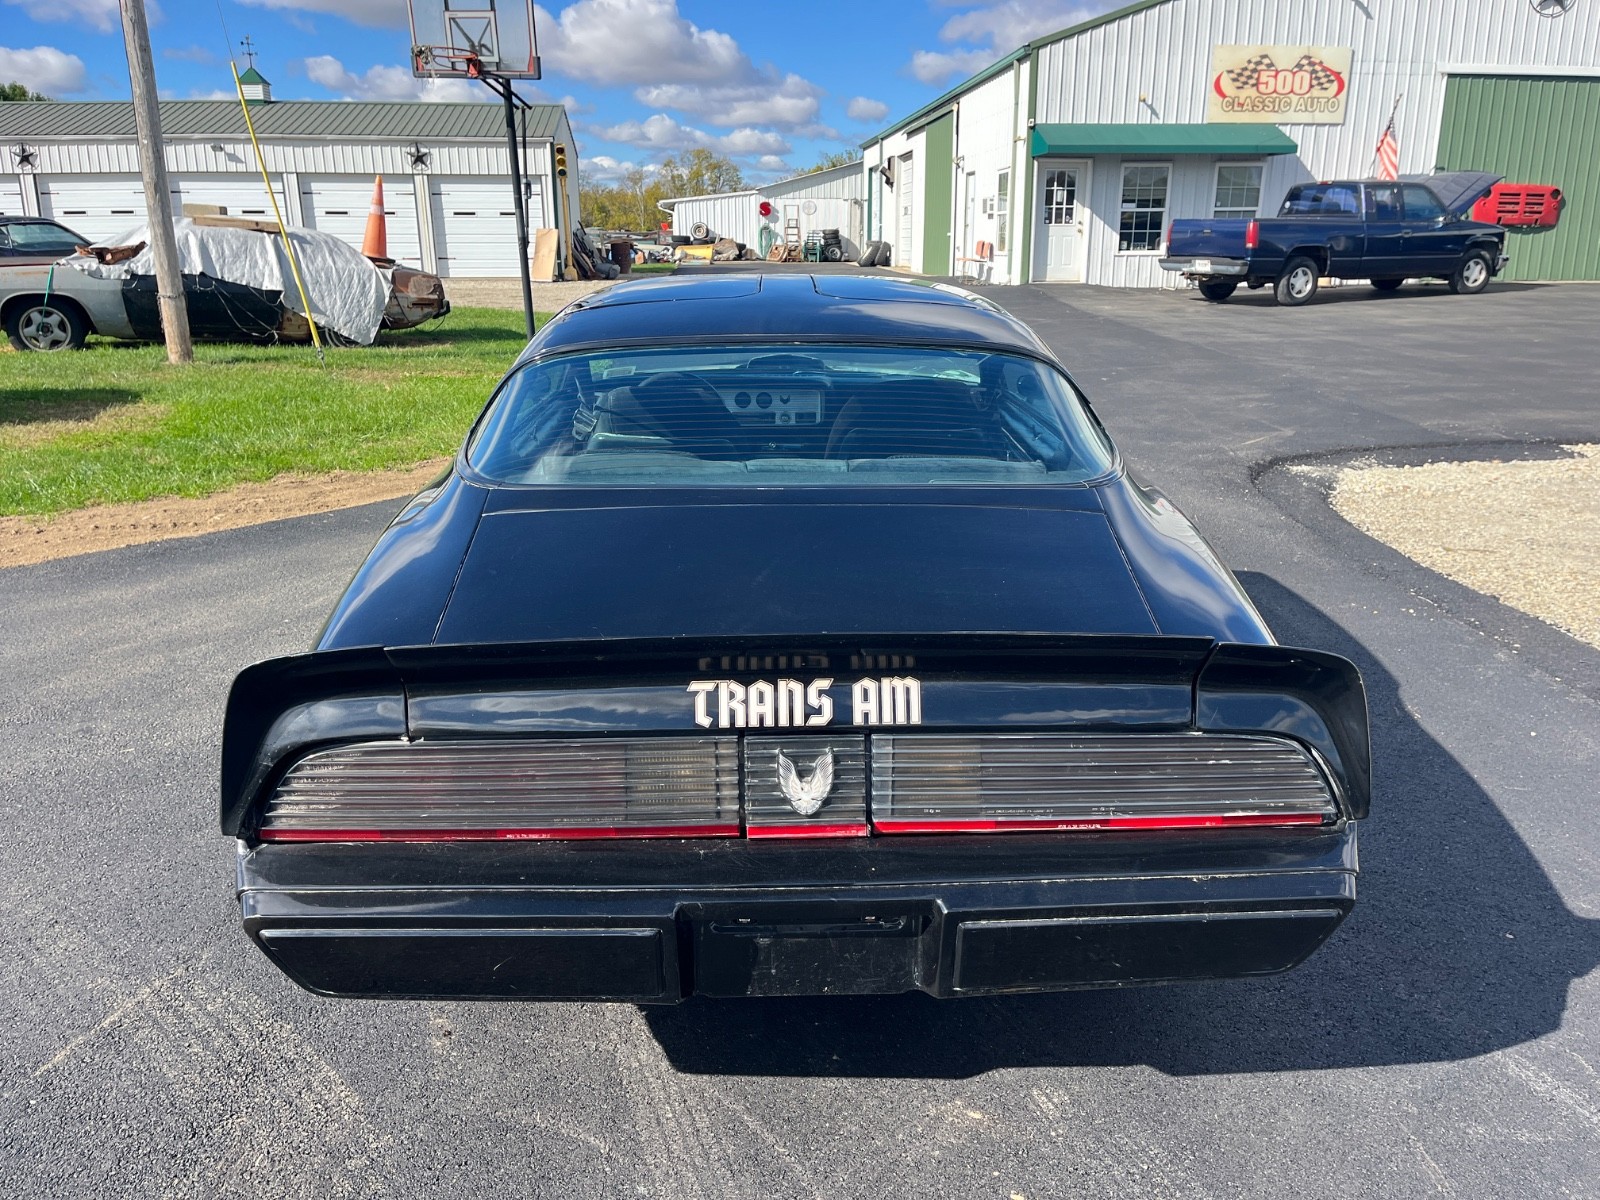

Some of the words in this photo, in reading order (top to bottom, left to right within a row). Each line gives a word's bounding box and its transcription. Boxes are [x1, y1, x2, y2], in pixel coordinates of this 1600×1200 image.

[1257, 70, 1312, 95] 500
[1222, 96, 1291, 113] CLASSIC
[1294, 96, 1339, 113] AUTO
[759, 201, 771, 216] S
[686, 677, 834, 728] TRANS
[852, 676, 921, 725] AM
